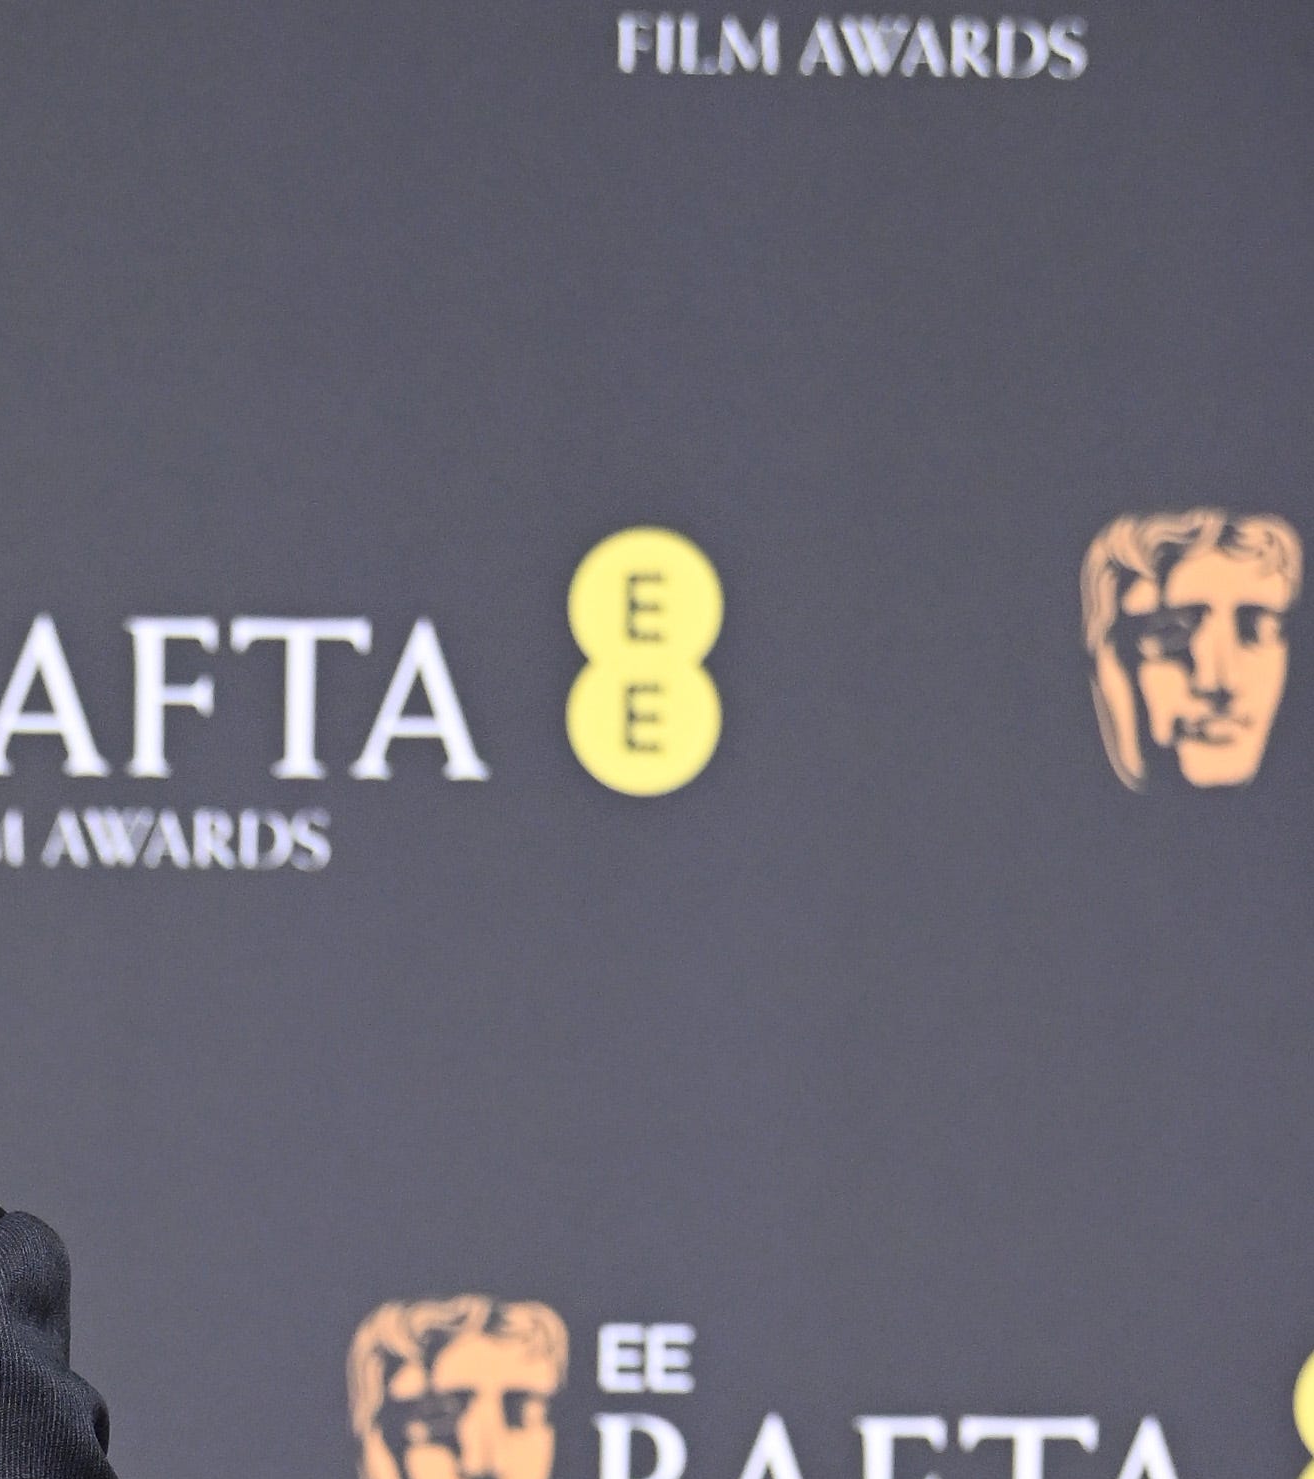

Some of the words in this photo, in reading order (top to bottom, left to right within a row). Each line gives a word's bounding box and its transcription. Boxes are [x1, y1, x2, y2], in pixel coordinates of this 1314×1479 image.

[618, 14, 779, 75] FILM
[800, 17, 1087, 78] AWARDS
[42, 808, 331, 870] AWARDS
[597, 1323, 695, 1393] EE
